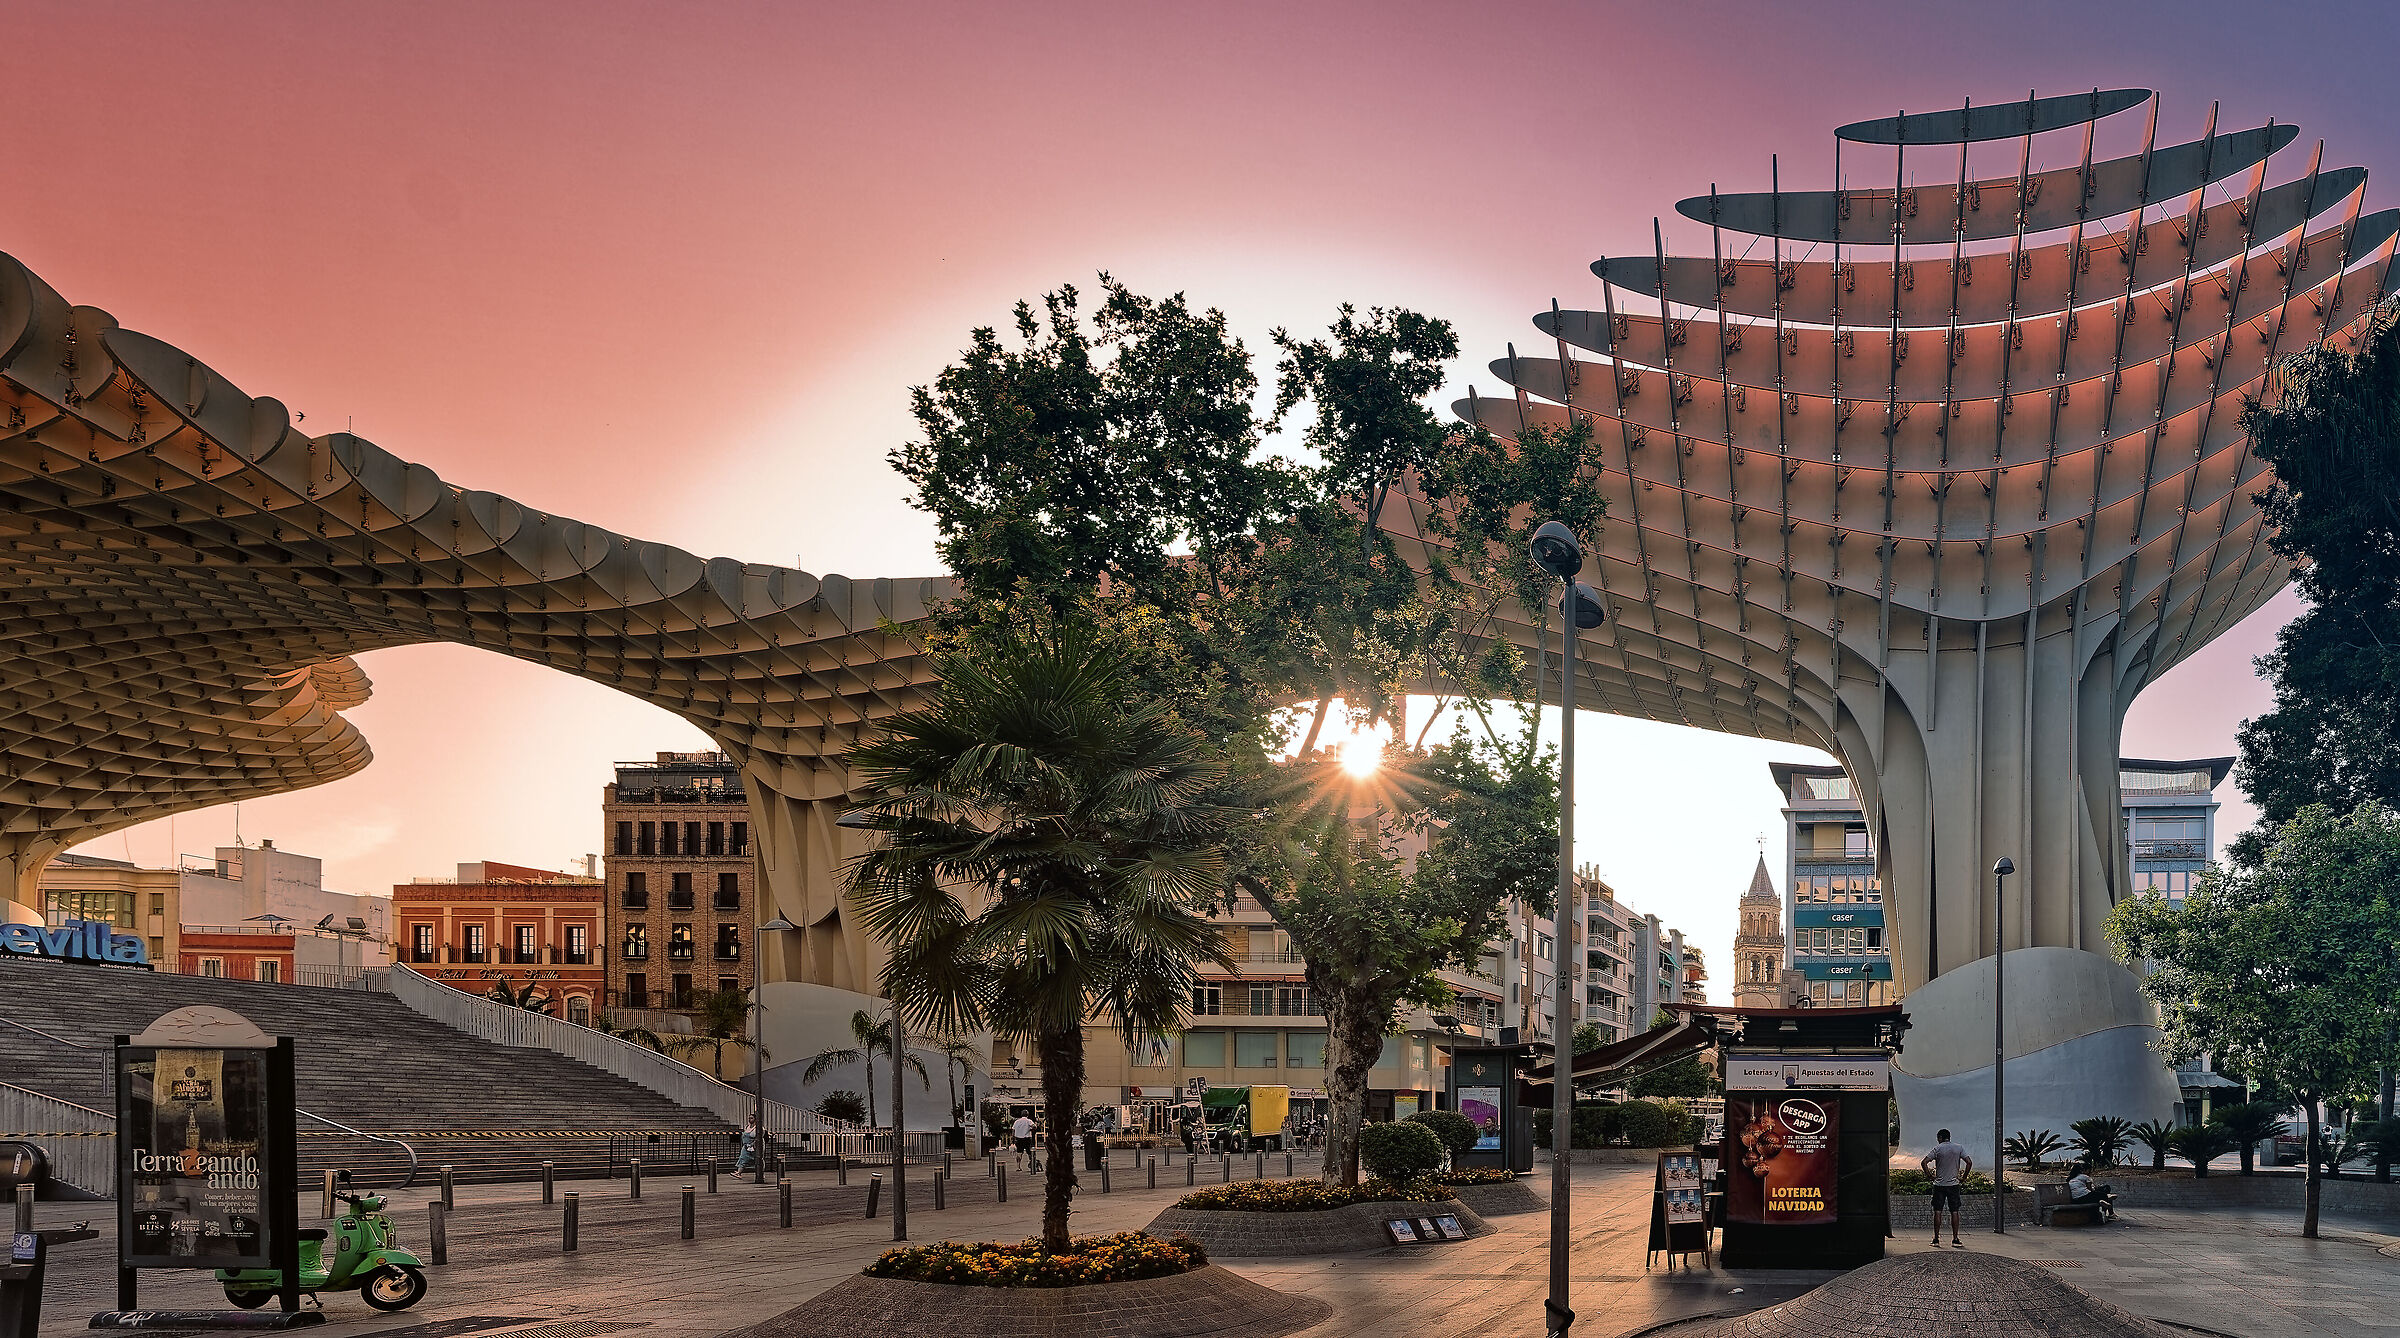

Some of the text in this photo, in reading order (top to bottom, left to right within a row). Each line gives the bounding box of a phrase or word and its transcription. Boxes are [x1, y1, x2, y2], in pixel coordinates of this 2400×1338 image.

[1832, 914, 1854, 922] caser
[435, 968, 467, 980] Hotel
[1743, 1068, 1874, 1078] Loterías y Apuestas del Estado
[1782, 1105, 1824, 1125] DESCARGA
[1793, 1118, 1811, 1129] APP
[1771, 1187, 1822, 1198] LOTERIA
[1768, 1200, 1825, 1211] NAVIDAD
